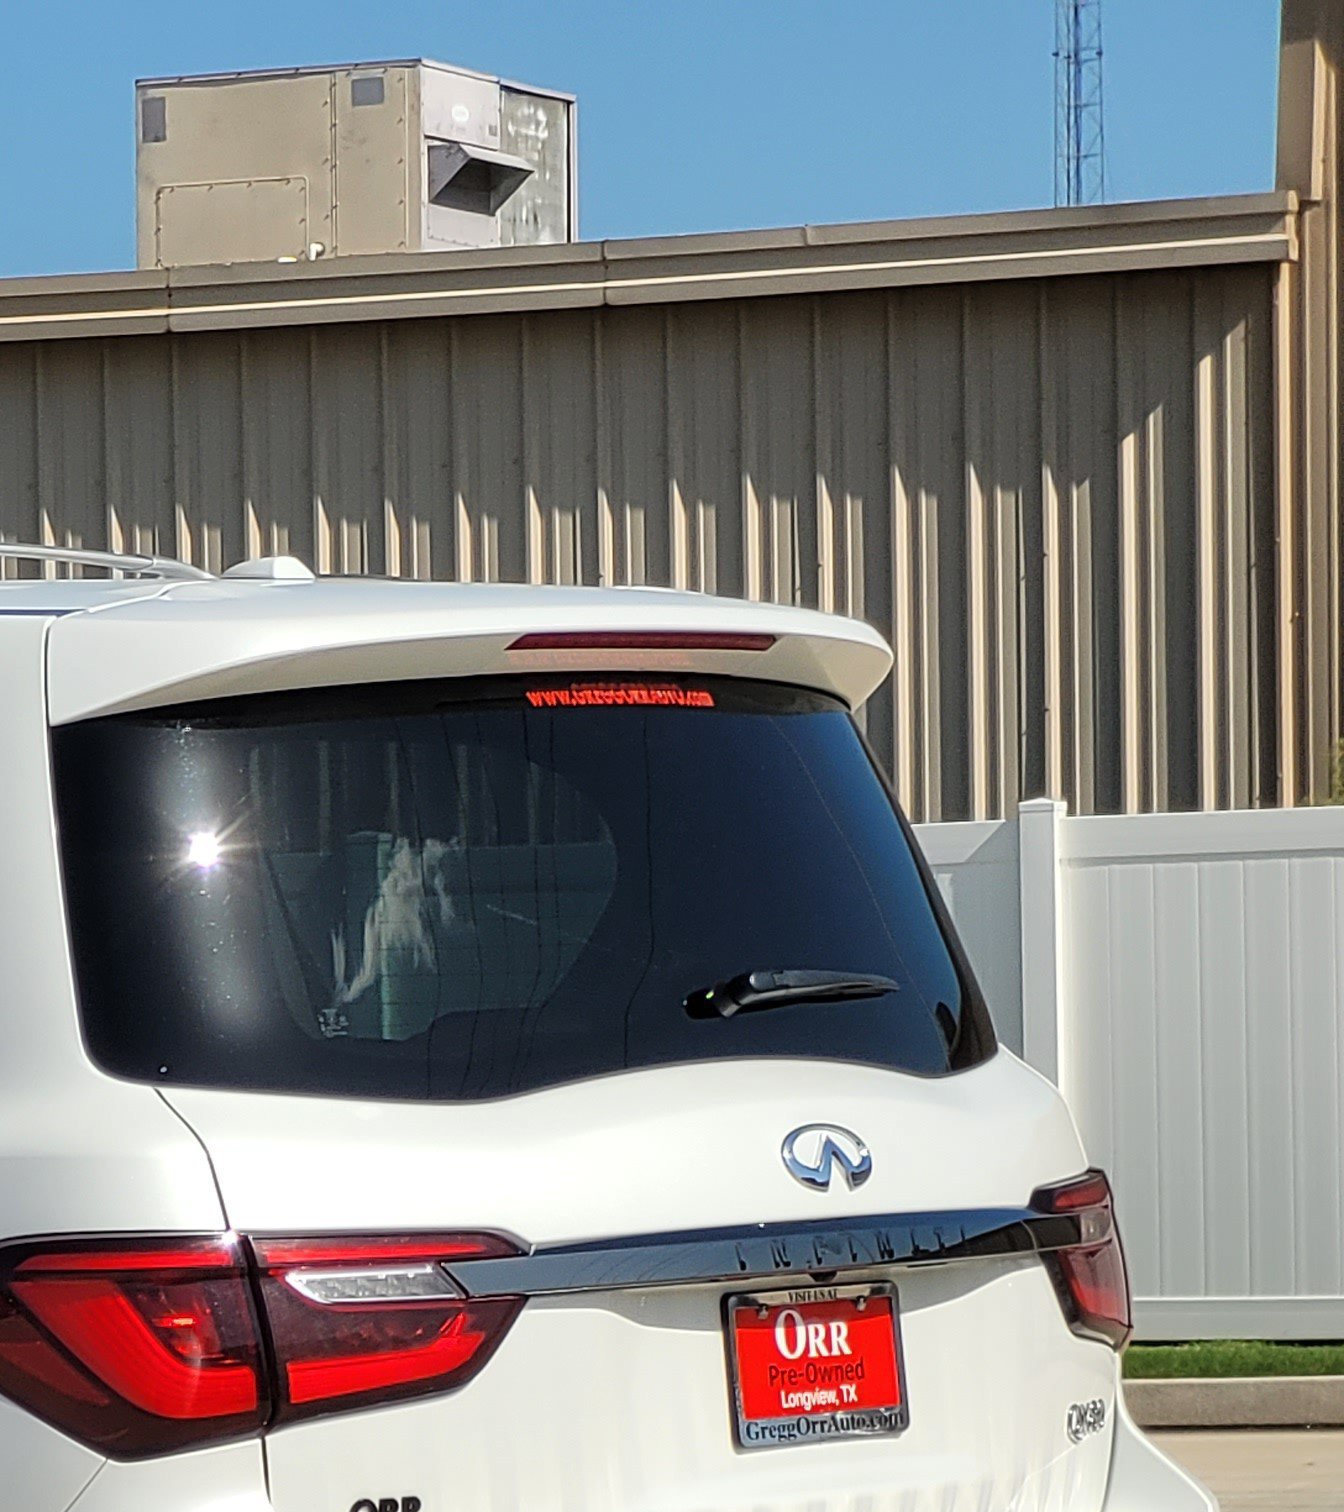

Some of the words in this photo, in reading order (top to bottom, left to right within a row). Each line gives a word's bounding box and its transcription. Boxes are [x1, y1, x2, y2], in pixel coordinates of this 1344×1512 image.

[768, 1356, 866, 1387] Pre-Owned
[780, 1387, 840, 1411] Longview,
[840, 1383, 859, 1403] TX
[745, 1411, 905, 1443] GreggOrrAuto.com
